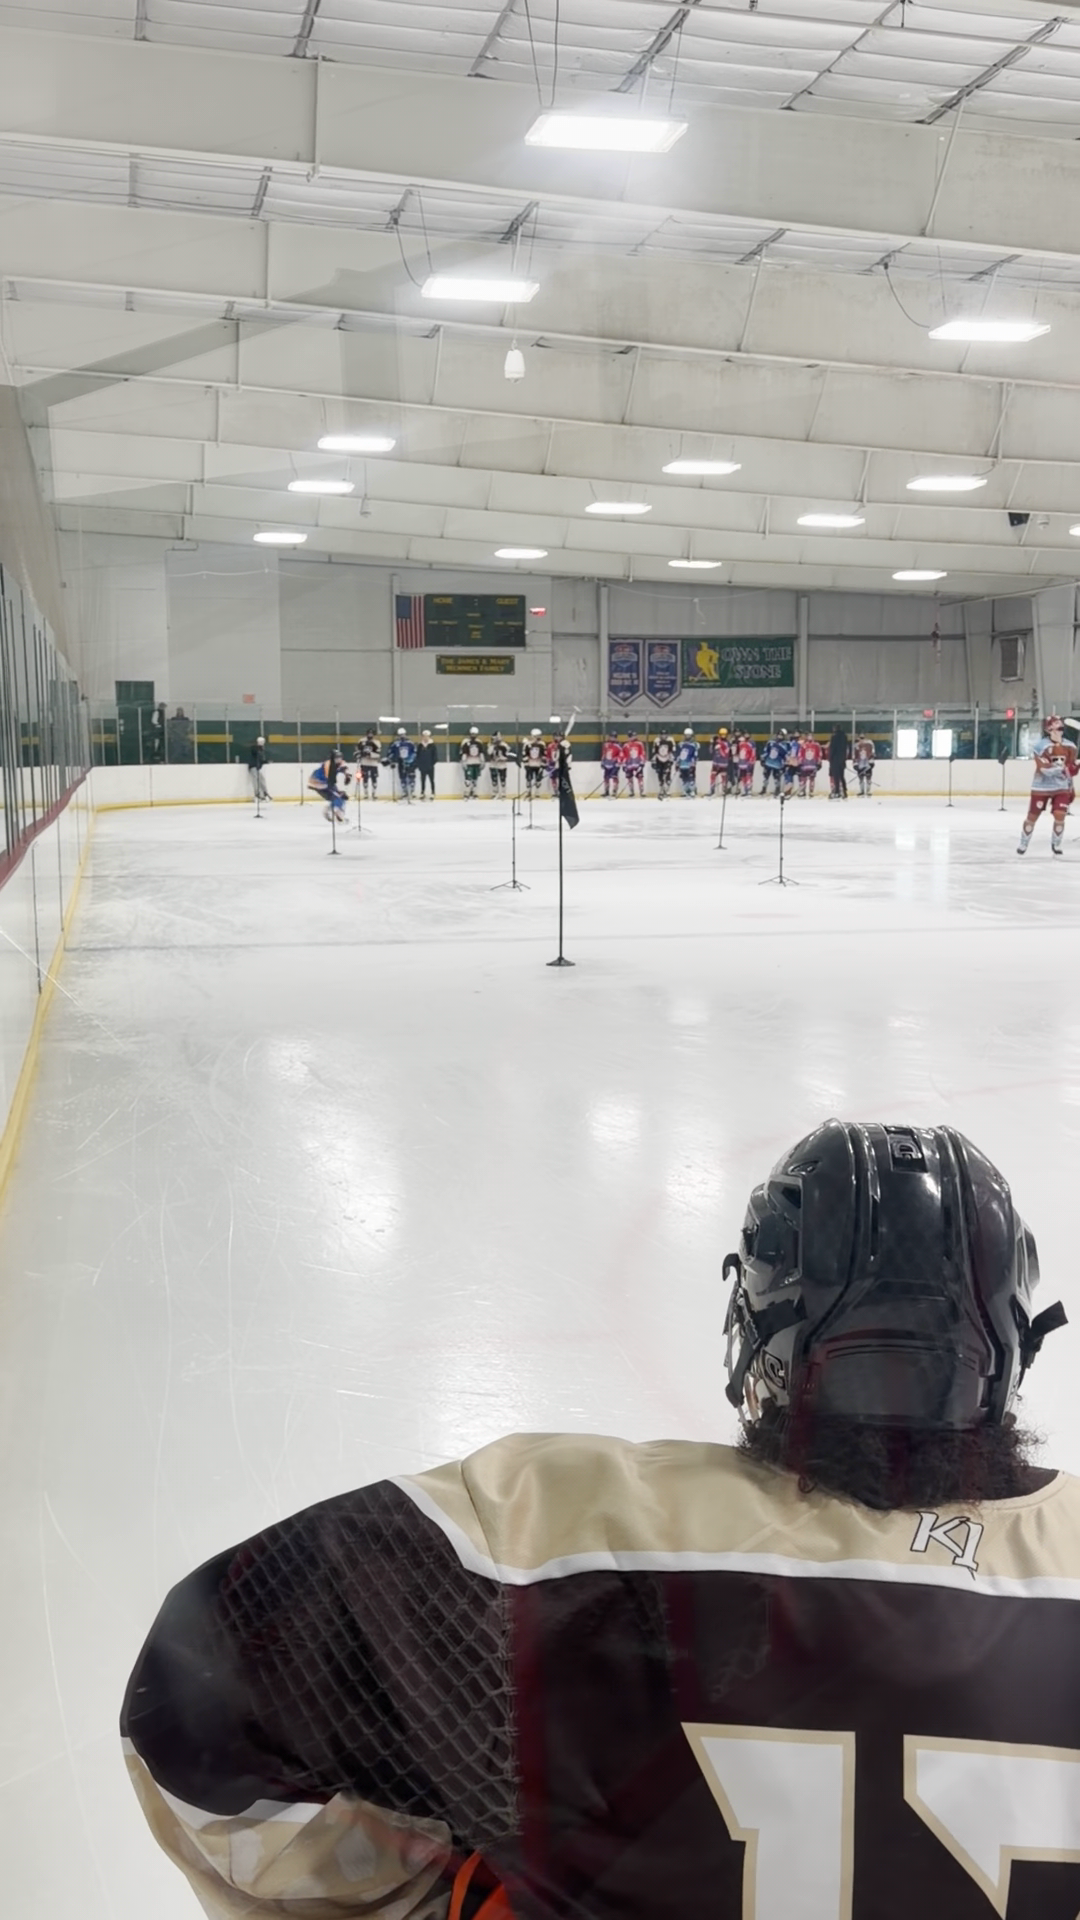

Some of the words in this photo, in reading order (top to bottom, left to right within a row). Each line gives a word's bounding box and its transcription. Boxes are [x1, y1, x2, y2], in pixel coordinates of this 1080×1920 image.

[721, 647, 760, 662] OWN
[763, 646, 792, 661] THE
[734, 664, 782, 679] STONE
